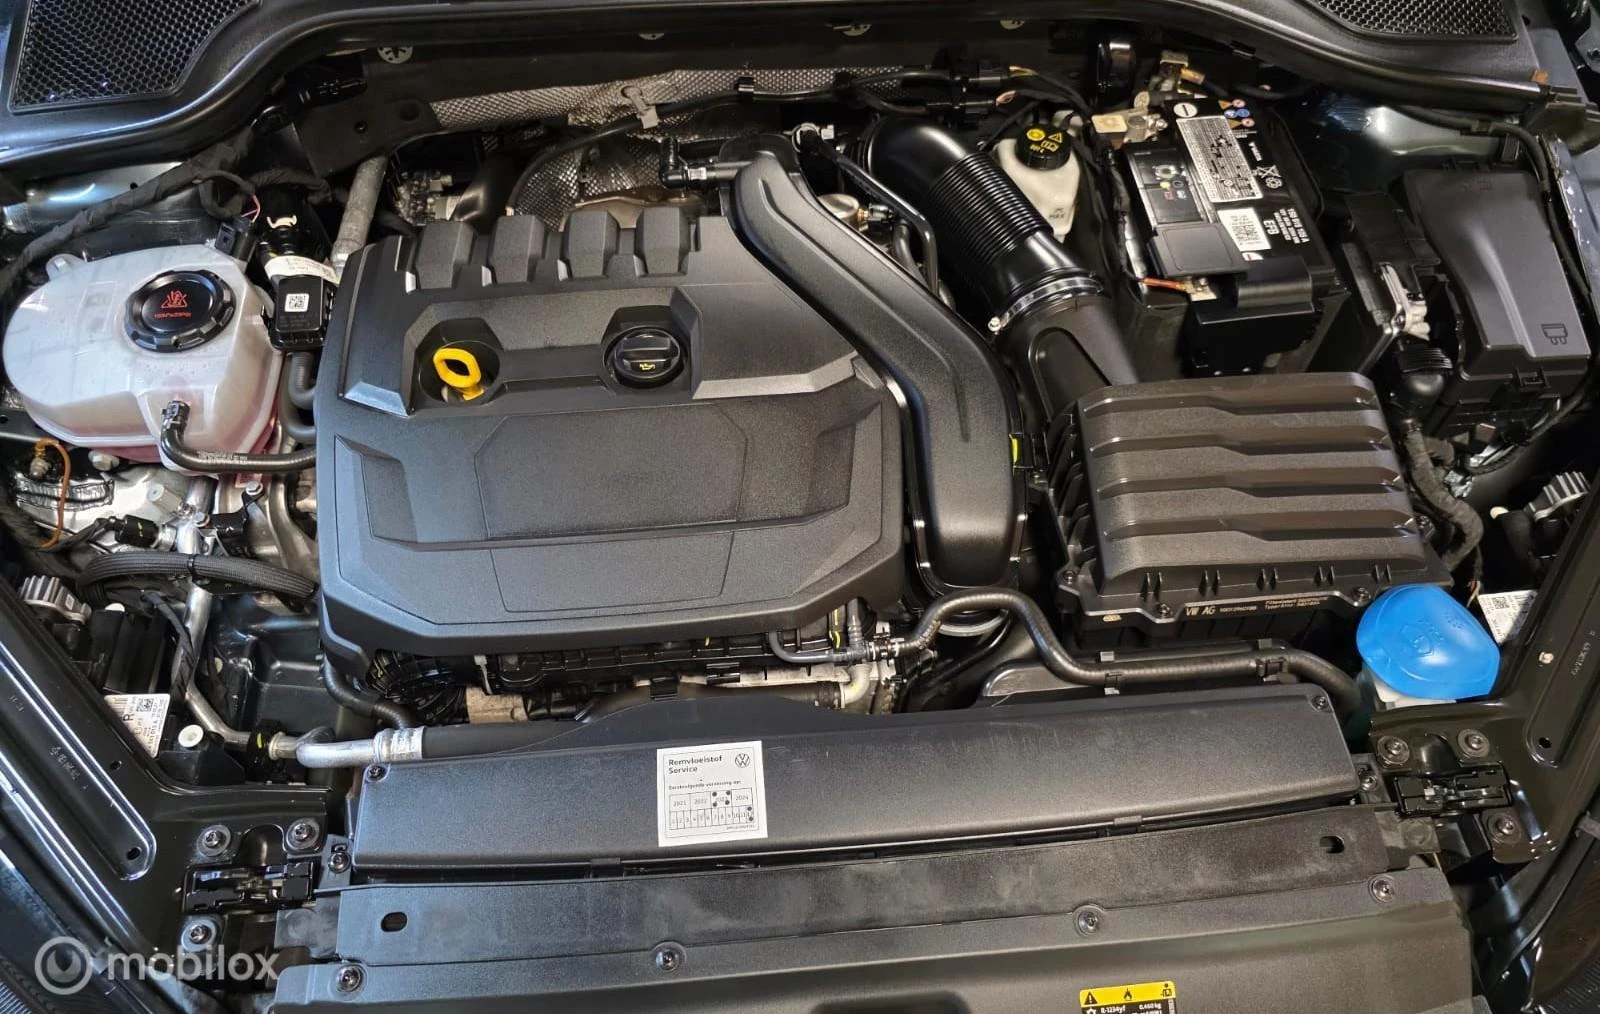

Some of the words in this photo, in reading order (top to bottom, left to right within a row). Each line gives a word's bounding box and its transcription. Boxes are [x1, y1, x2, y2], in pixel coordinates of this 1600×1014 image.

[1264, 220, 1280, 234] EFB
[1201, 605, 1216, 616] AG
[668, 755, 722, 766] Remvloeistof
[668, 766, 698, 775] Service
